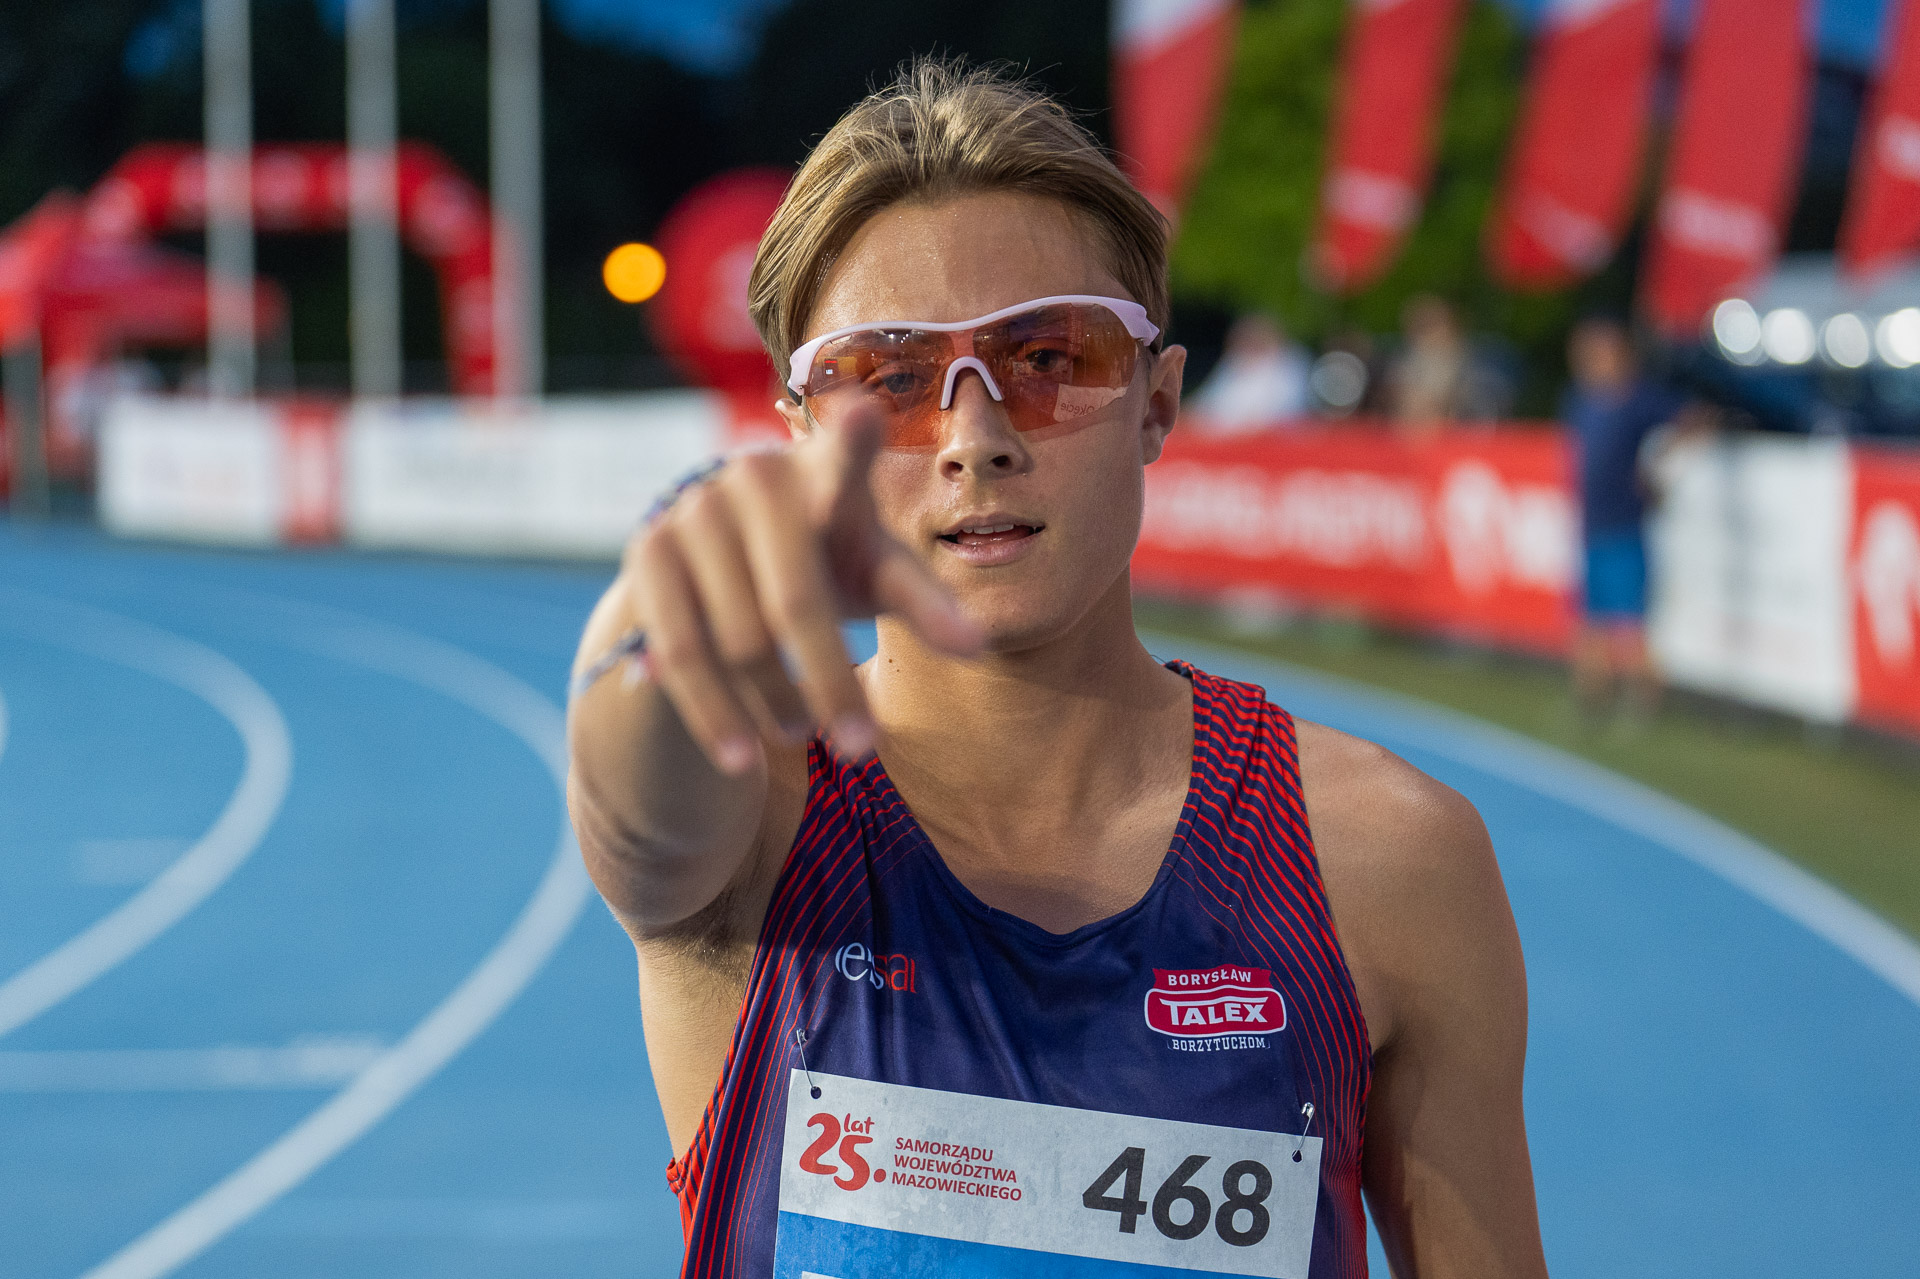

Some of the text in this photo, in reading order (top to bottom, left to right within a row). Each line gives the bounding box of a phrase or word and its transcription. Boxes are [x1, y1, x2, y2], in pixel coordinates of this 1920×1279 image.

[1168, 969, 1251, 986] BORYSŁAW
[1159, 996, 1268, 1026] TALEX
[1172, 1036, 1265, 1052] BORZYTUCHOM
[843, 1113, 875, 1134] lat
[895, 1137, 994, 1163] SAMORZĄDU
[894, 1154, 1017, 1183] WOJEWÓDZTWA
[891, 1171, 1022, 1202] MAZOWIECKIEGO
[1082, 1146, 1273, 1247] 468
